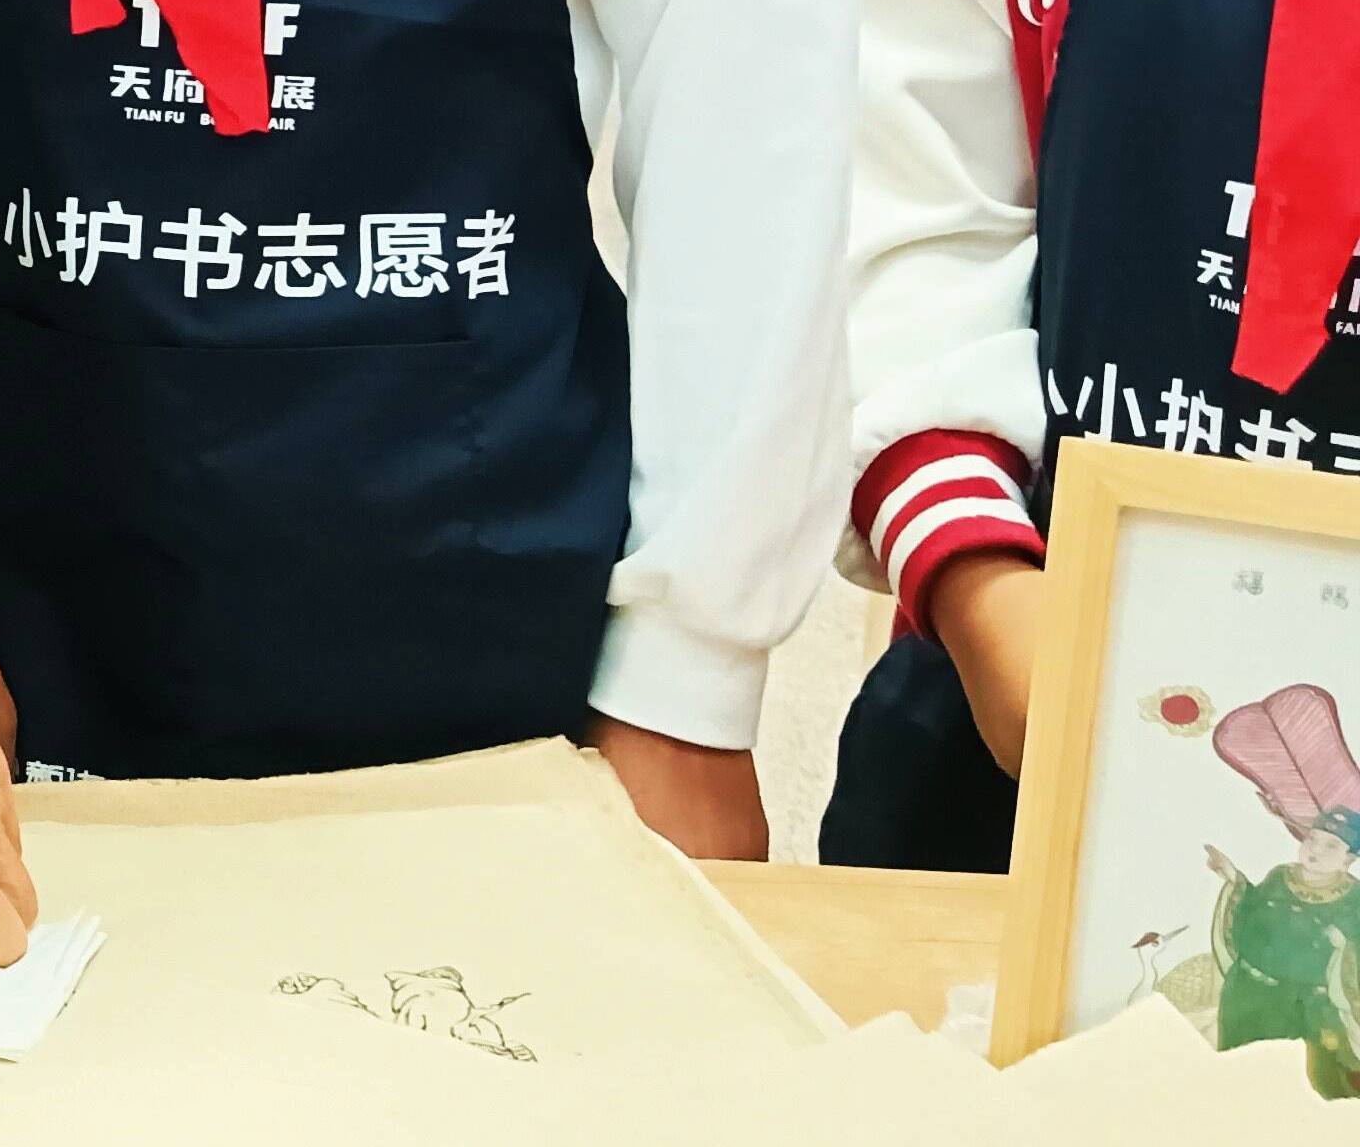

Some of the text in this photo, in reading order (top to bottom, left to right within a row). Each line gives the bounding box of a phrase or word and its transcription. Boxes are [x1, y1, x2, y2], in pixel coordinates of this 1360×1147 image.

[109, 64, 316, 111] 天府展
[123, 107, 162, 122] TIAN
[164, 110, 185, 124] FU
[267, 117, 296, 131] AIR
